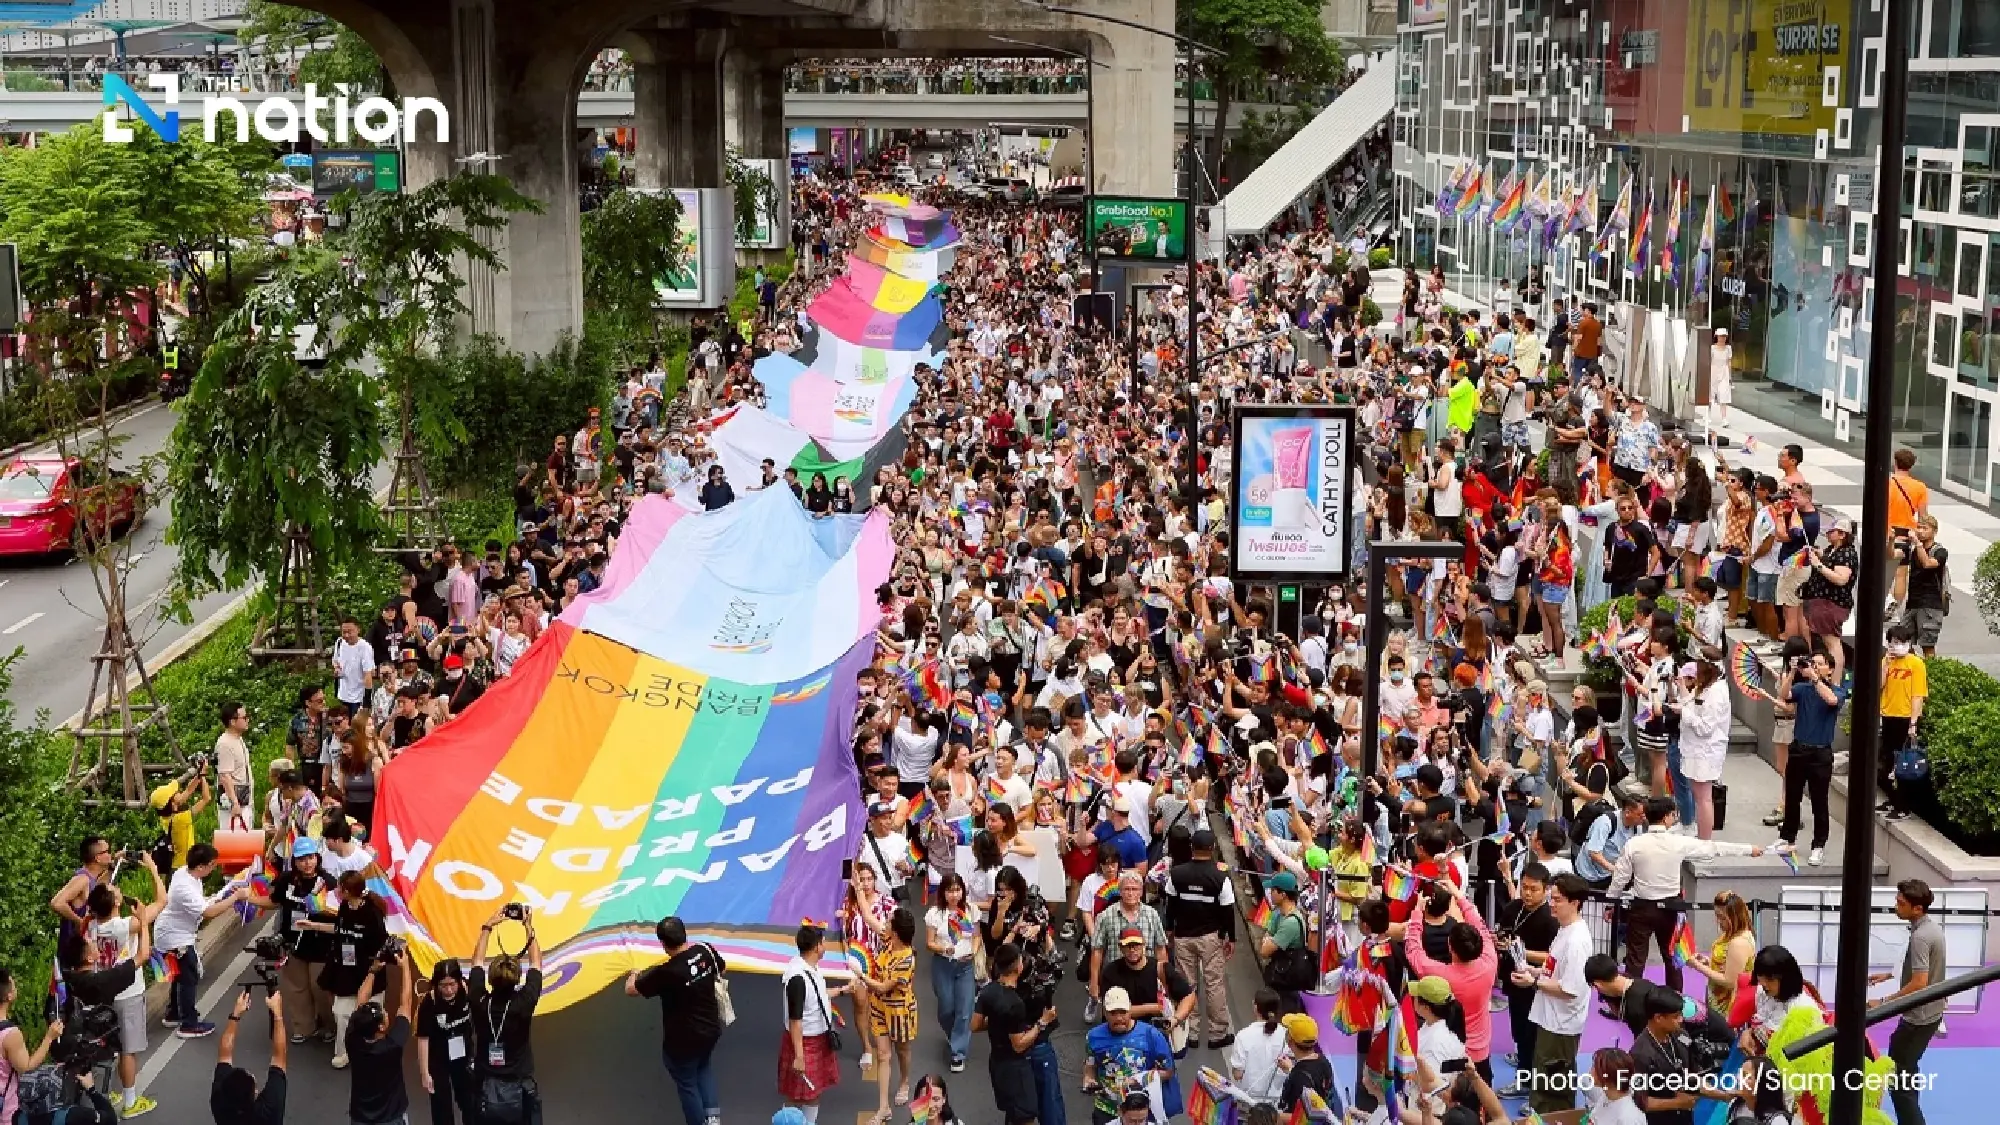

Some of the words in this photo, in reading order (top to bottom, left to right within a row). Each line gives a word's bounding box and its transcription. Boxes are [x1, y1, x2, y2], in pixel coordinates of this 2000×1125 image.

[1776, 23, 1839, 51] SURPRISE
[1096, 204, 1149, 216] GrabFood
[1149, 205, 1173, 218] No.1
[1325, 423, 1341, 468] DOLL
[1322, 474, 1339, 538] CATHY
[557, 662, 758, 717] BANGKOK
[648, 673, 763, 705] PRIDE
[480, 765, 815, 829] PARADE
[387, 802, 849, 916] BANGKOK
[499, 816, 756, 872] PRIDE
